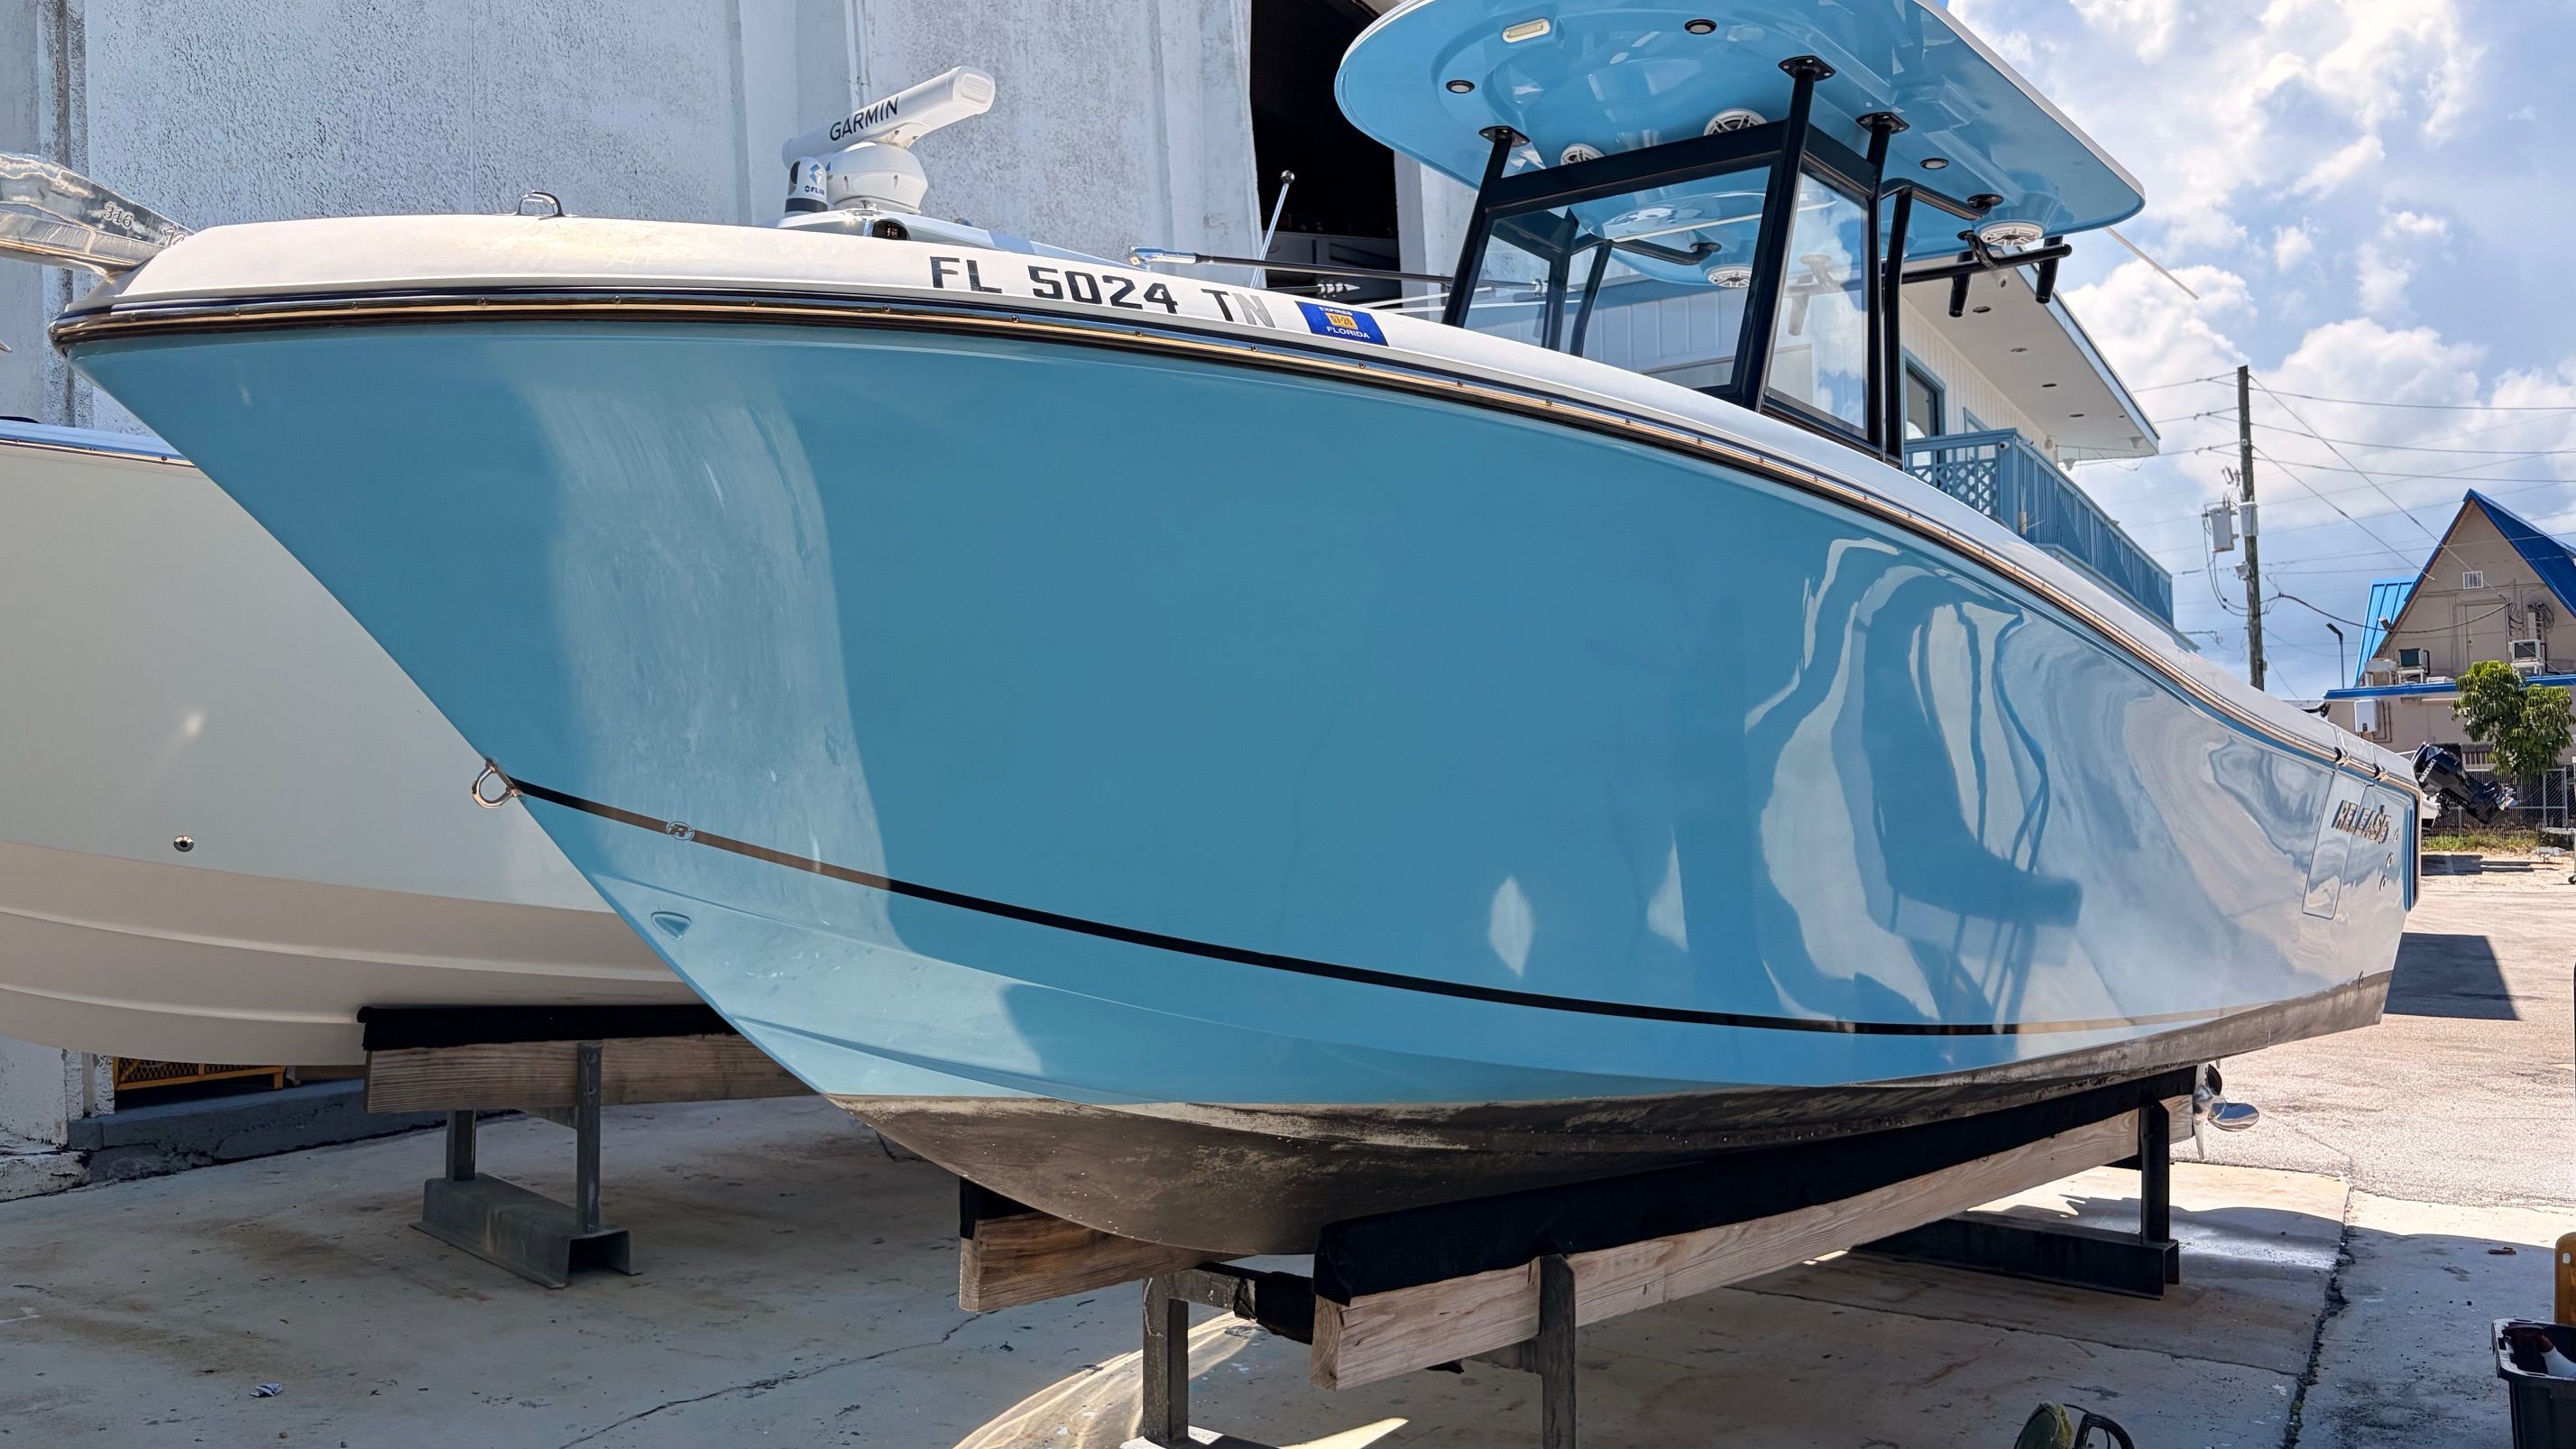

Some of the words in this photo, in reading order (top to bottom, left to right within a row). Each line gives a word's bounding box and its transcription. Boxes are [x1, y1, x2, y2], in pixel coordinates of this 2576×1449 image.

[830, 96, 899, 141] GARMIN
[104, 205, 133, 227] 316
[930, 256, 1002, 294] FL
[1027, 265, 1178, 315] 5024
[1201, 288, 1275, 328] TN
[1319, 307, 1353, 316] EXPIRES
[1326, 326, 1370, 339] FLORIDA
